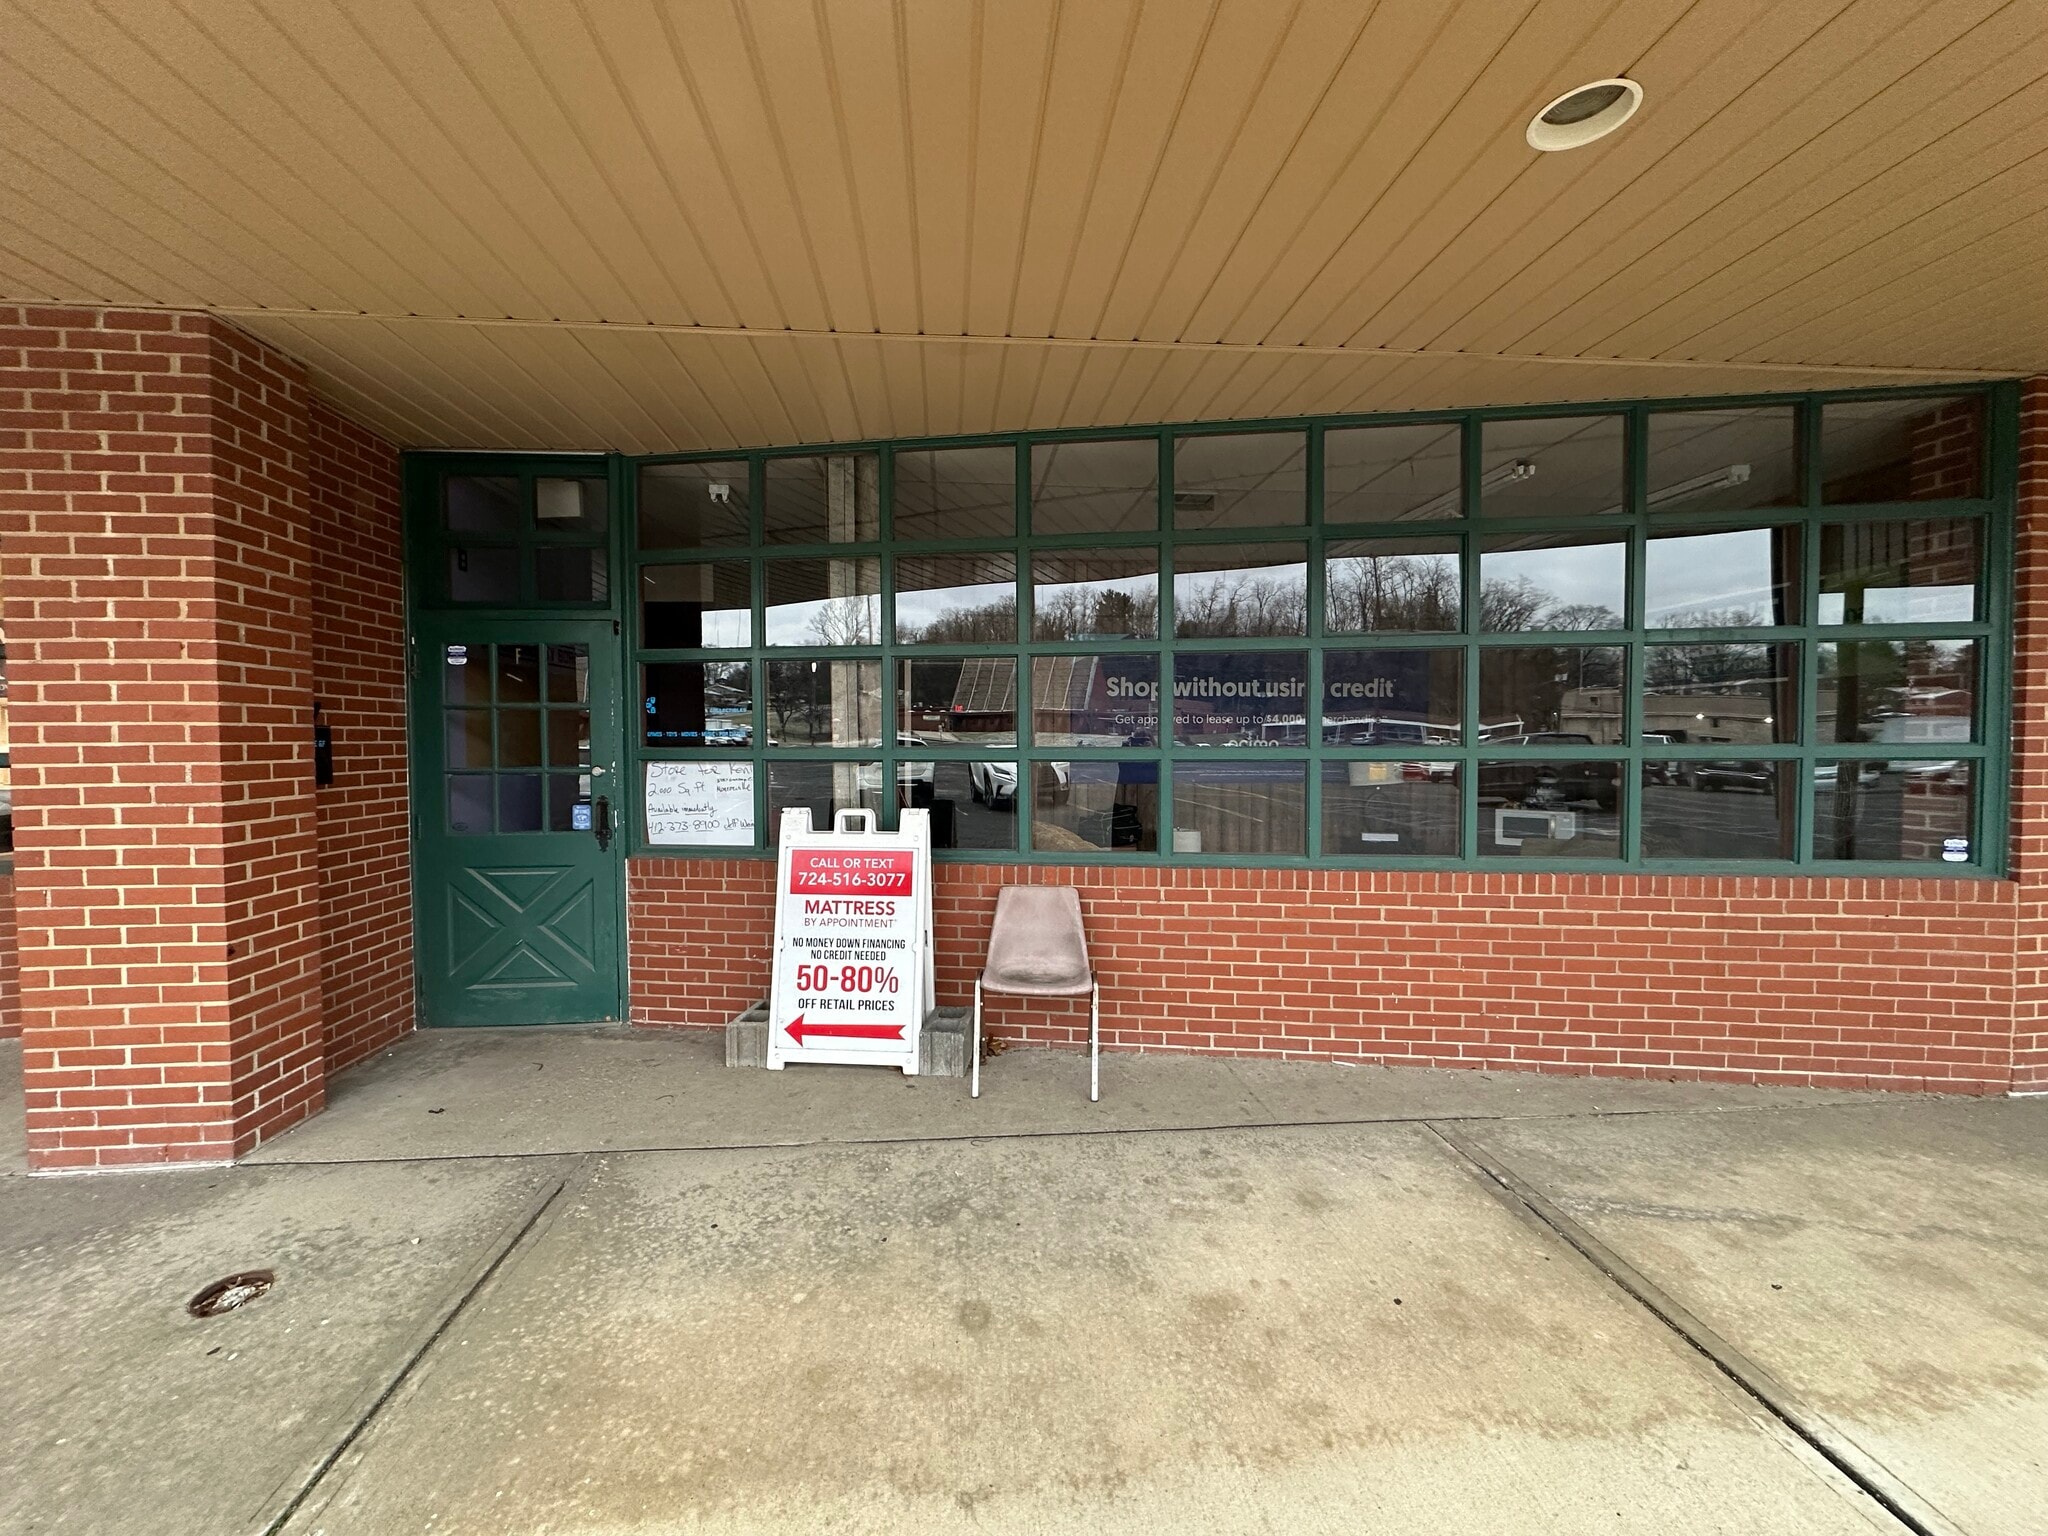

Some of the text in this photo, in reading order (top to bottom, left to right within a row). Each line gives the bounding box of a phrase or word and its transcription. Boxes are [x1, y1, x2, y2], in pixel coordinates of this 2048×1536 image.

[1174, 677, 1260, 697] without
[1330, 677, 1394, 698] credit
[1115, 714, 1135, 724] Get
[1193, 715, 1204, 724] to
[1206, 714, 1234, 724] lease
[1236, 716, 1250, 727] up
[1252, 715, 1264, 724] to
[810, 857, 895, 869] CALL OR TEXT
[798, 871, 906, 887] 724-516-3077
[804, 899, 896, 916] MATTRESS
[804, 917, 894, 928] BY APPOINTMENT
[792, 937, 906, 950] NO MONEY DOWN FINANCING
[810, 949, 886, 961] NO CREDIT NEEDED
[796, 964, 899, 994] 50-80%
[798, 998, 895, 1012] OFF RETAIL PRICES
